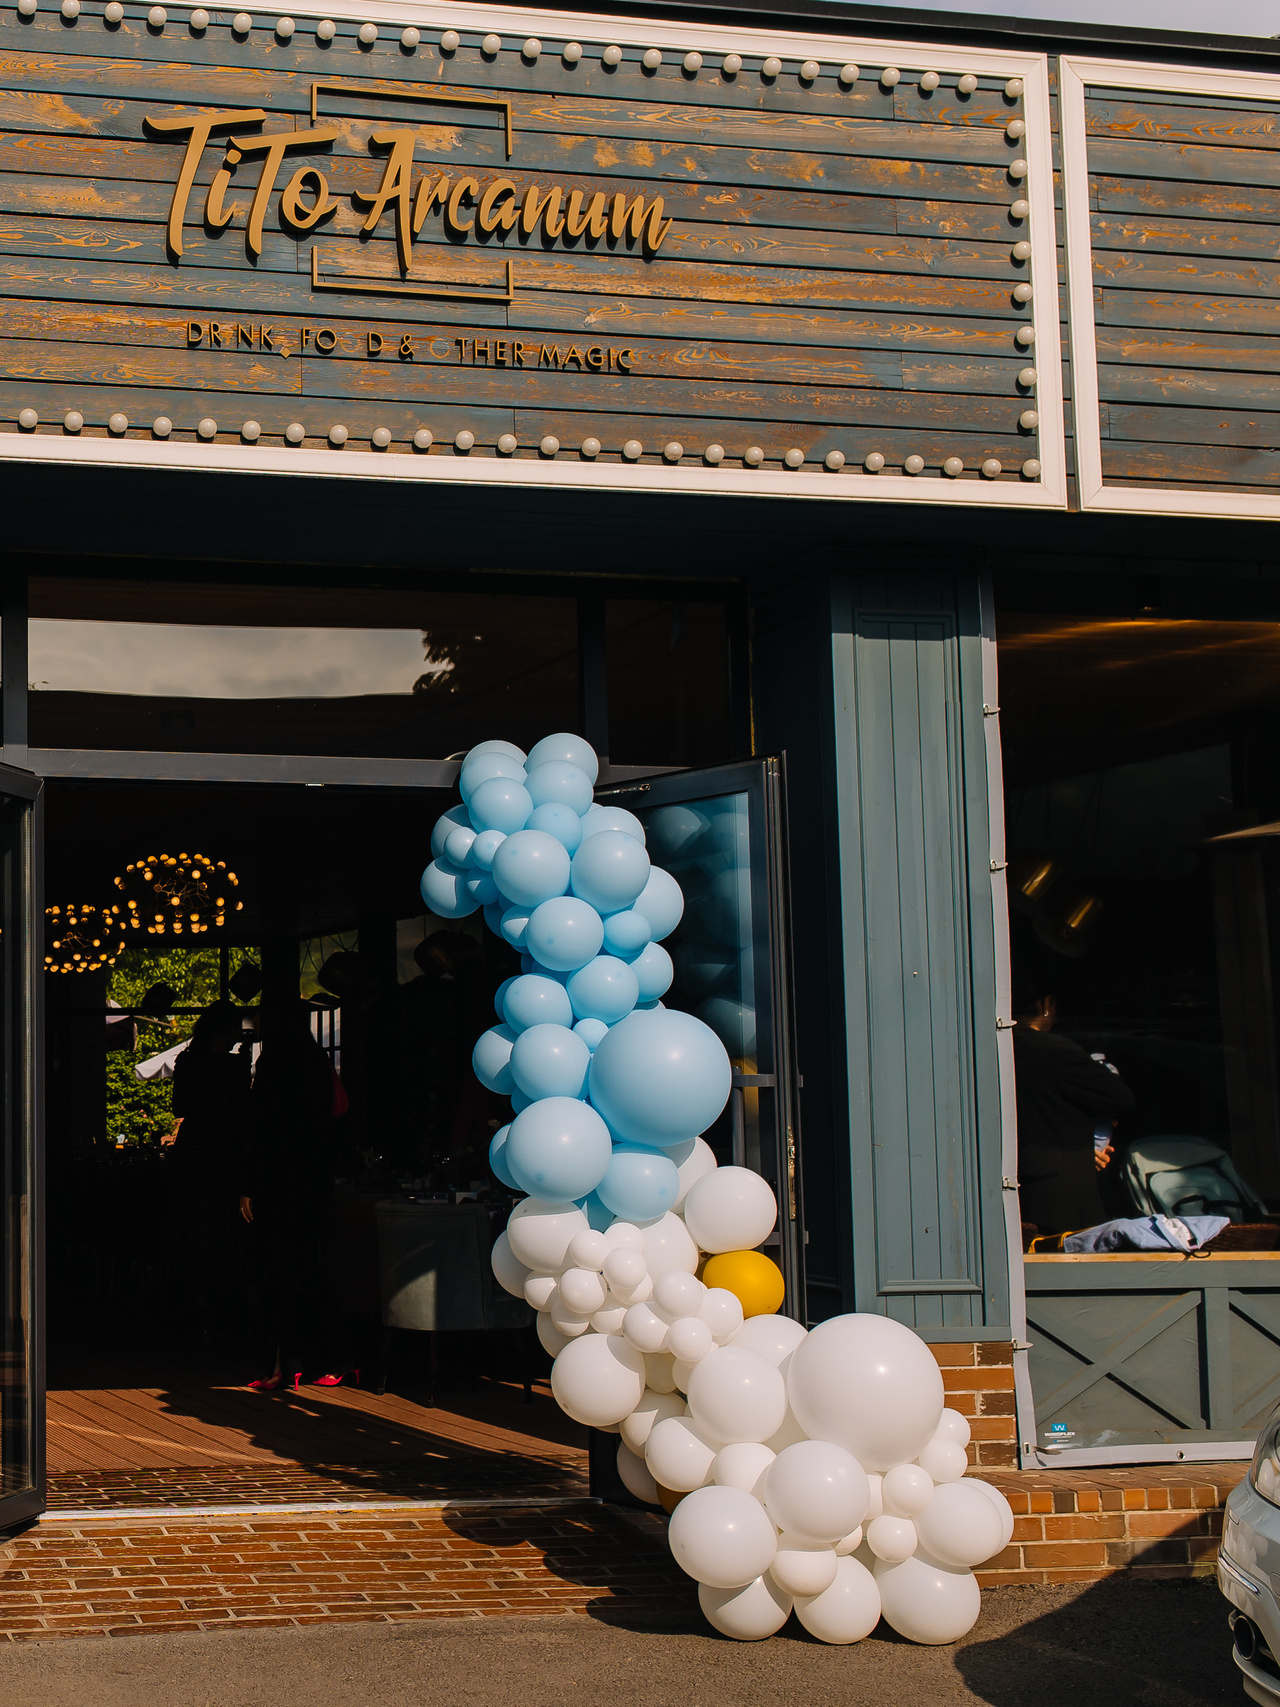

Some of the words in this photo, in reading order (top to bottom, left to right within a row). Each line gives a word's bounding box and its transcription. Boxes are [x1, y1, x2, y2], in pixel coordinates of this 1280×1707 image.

[143, 108, 340, 260] TiTo
[352, 128, 673, 273] Arcanum
[399, 333, 416, 356] &
[538, 343, 635, 369] MAGIC
